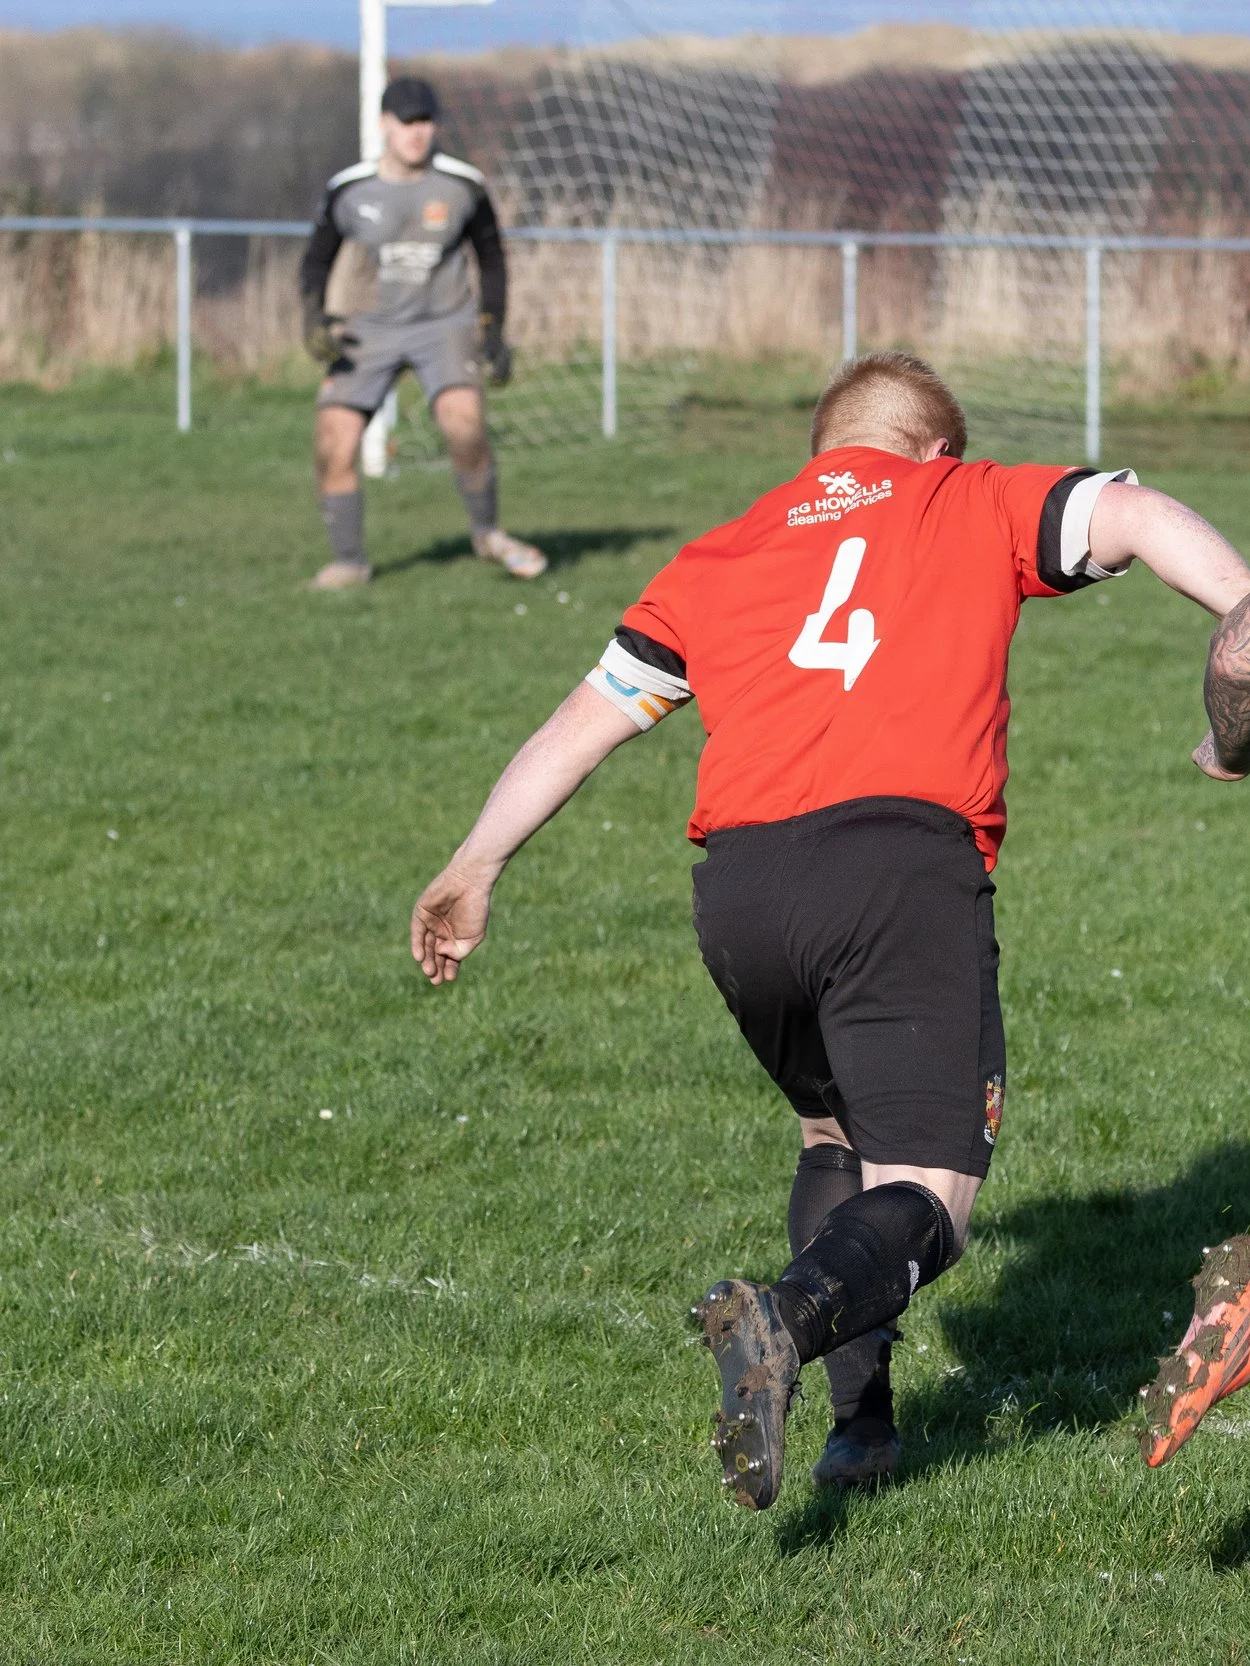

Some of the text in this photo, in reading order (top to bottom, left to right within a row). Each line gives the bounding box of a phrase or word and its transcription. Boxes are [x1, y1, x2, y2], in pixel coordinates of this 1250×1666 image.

[787, 479, 893, 518] RG HOWELLS
[787, 489, 893, 527] cleaning services
[787, 536, 882, 692] 4
